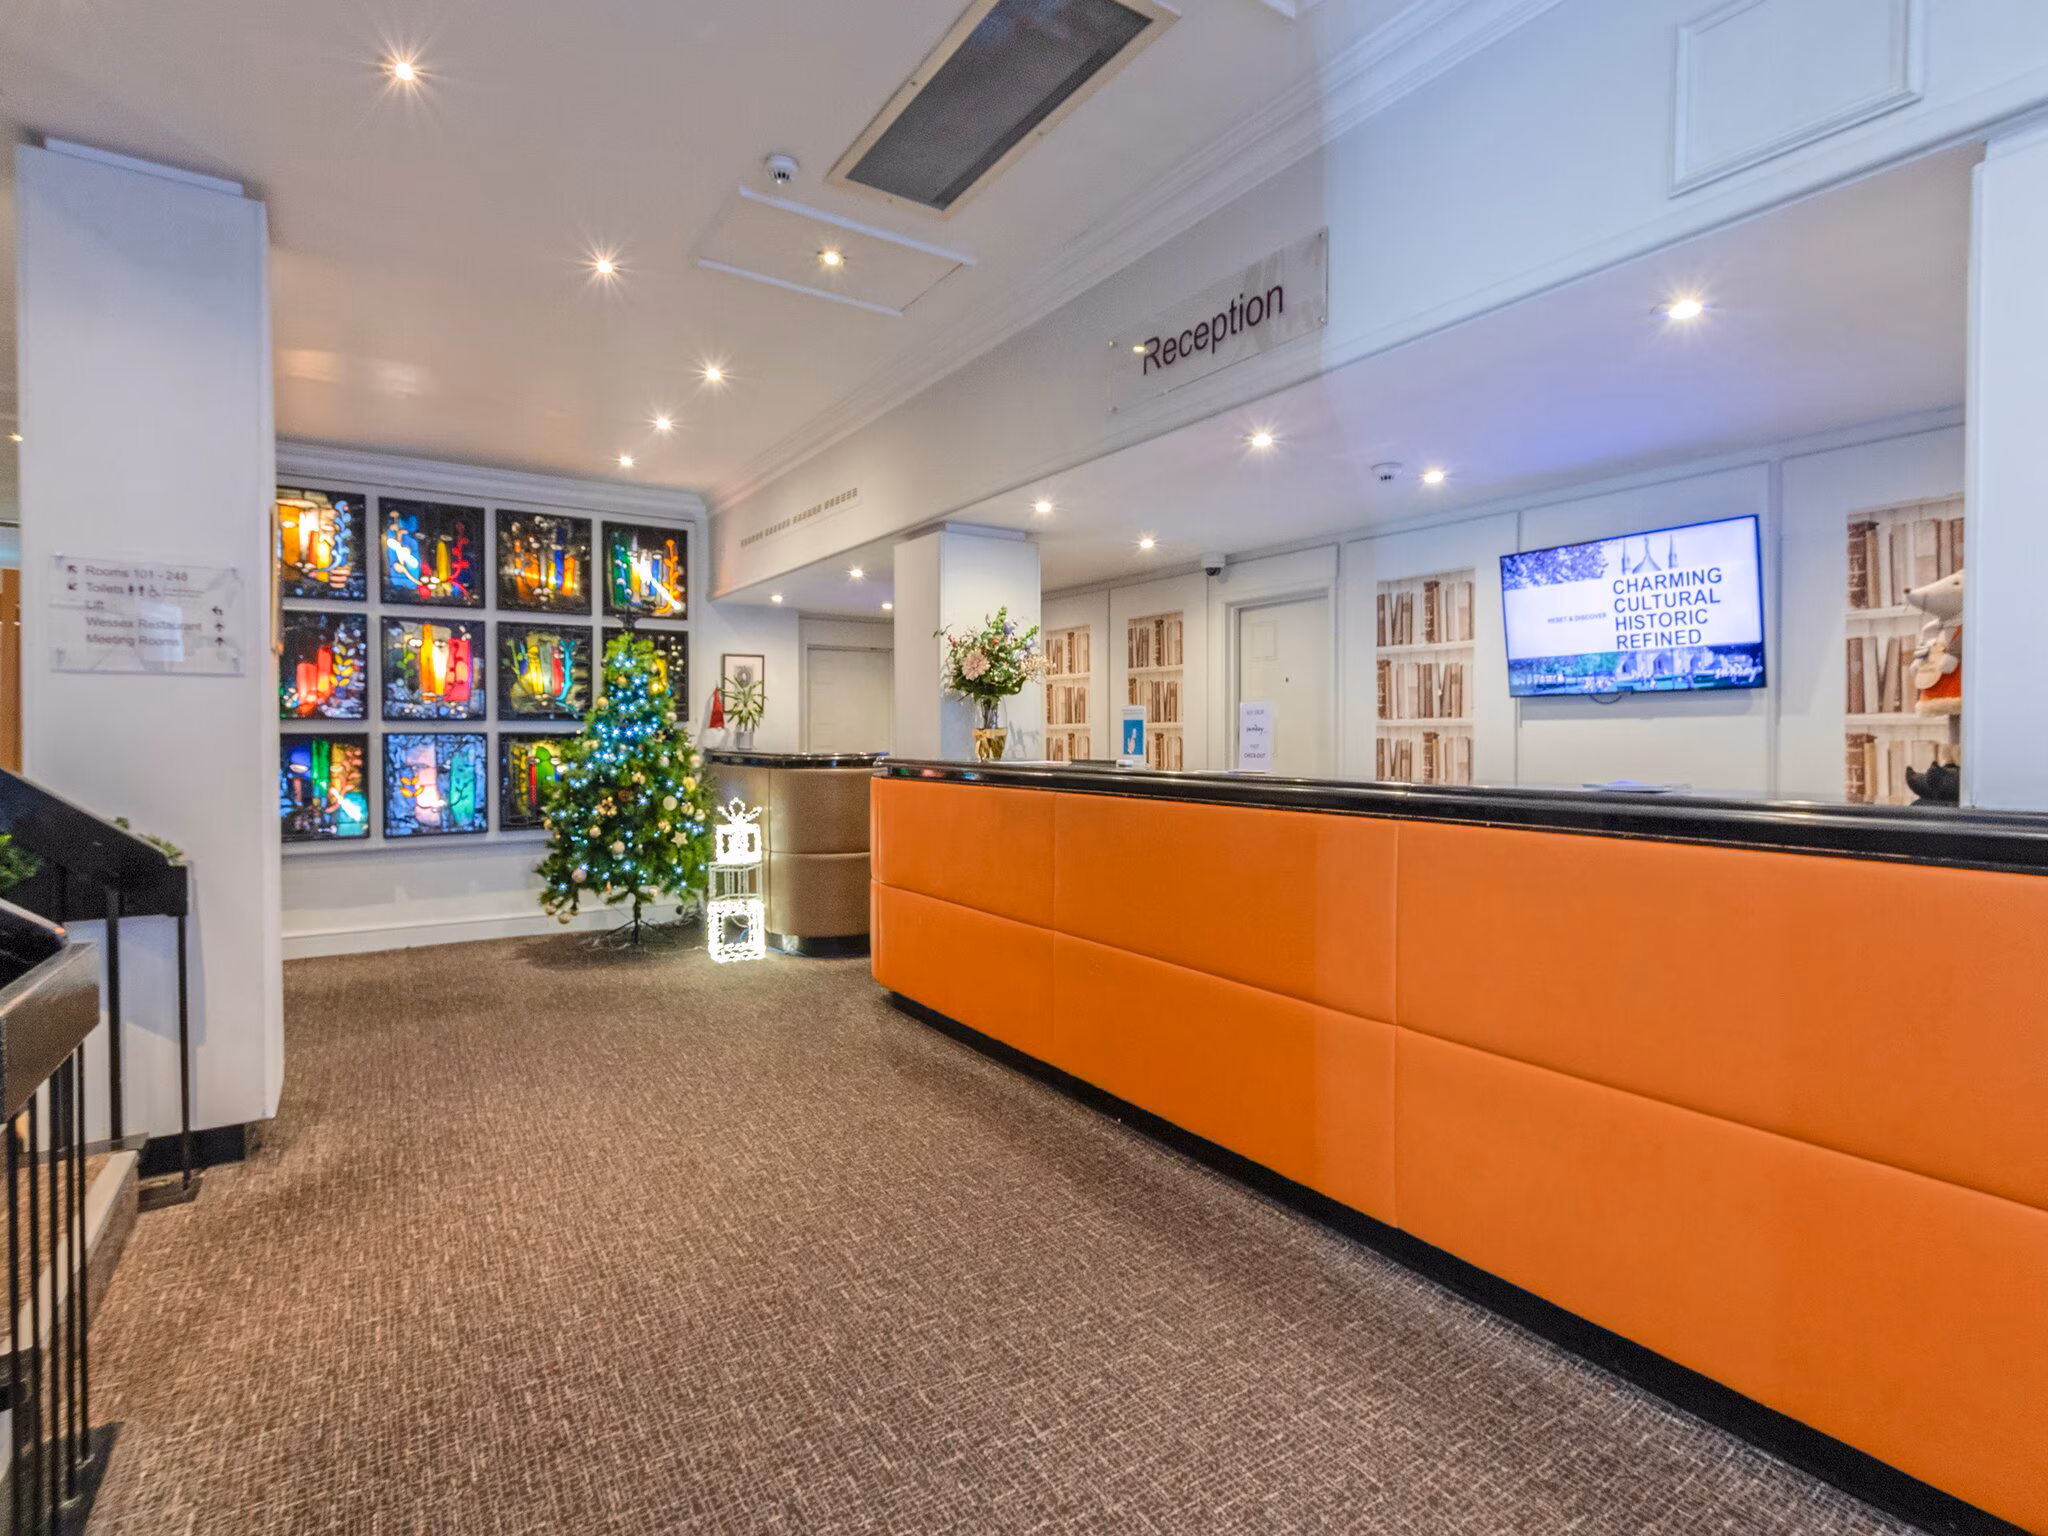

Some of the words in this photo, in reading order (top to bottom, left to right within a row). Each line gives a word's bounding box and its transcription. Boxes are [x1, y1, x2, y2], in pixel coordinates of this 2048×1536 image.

[1143, 285, 1283, 375] Reception
[86, 565, 129, 578] Rooms
[134, 569, 154, 579] 101
[1613, 567, 1722, 595] CHARMING
[86, 582, 124, 594] Toilets
[1614, 588, 1721, 613] CULTURAL
[86, 617, 133, 628] Wessex
[138, 619, 202, 631] Restaurant
[1615, 608, 1708, 631] HISTORIC
[86, 634, 134, 647] Meeting
[138, 636, 179, 646] Rooms
[1617, 629, 1702, 650] REFINED
